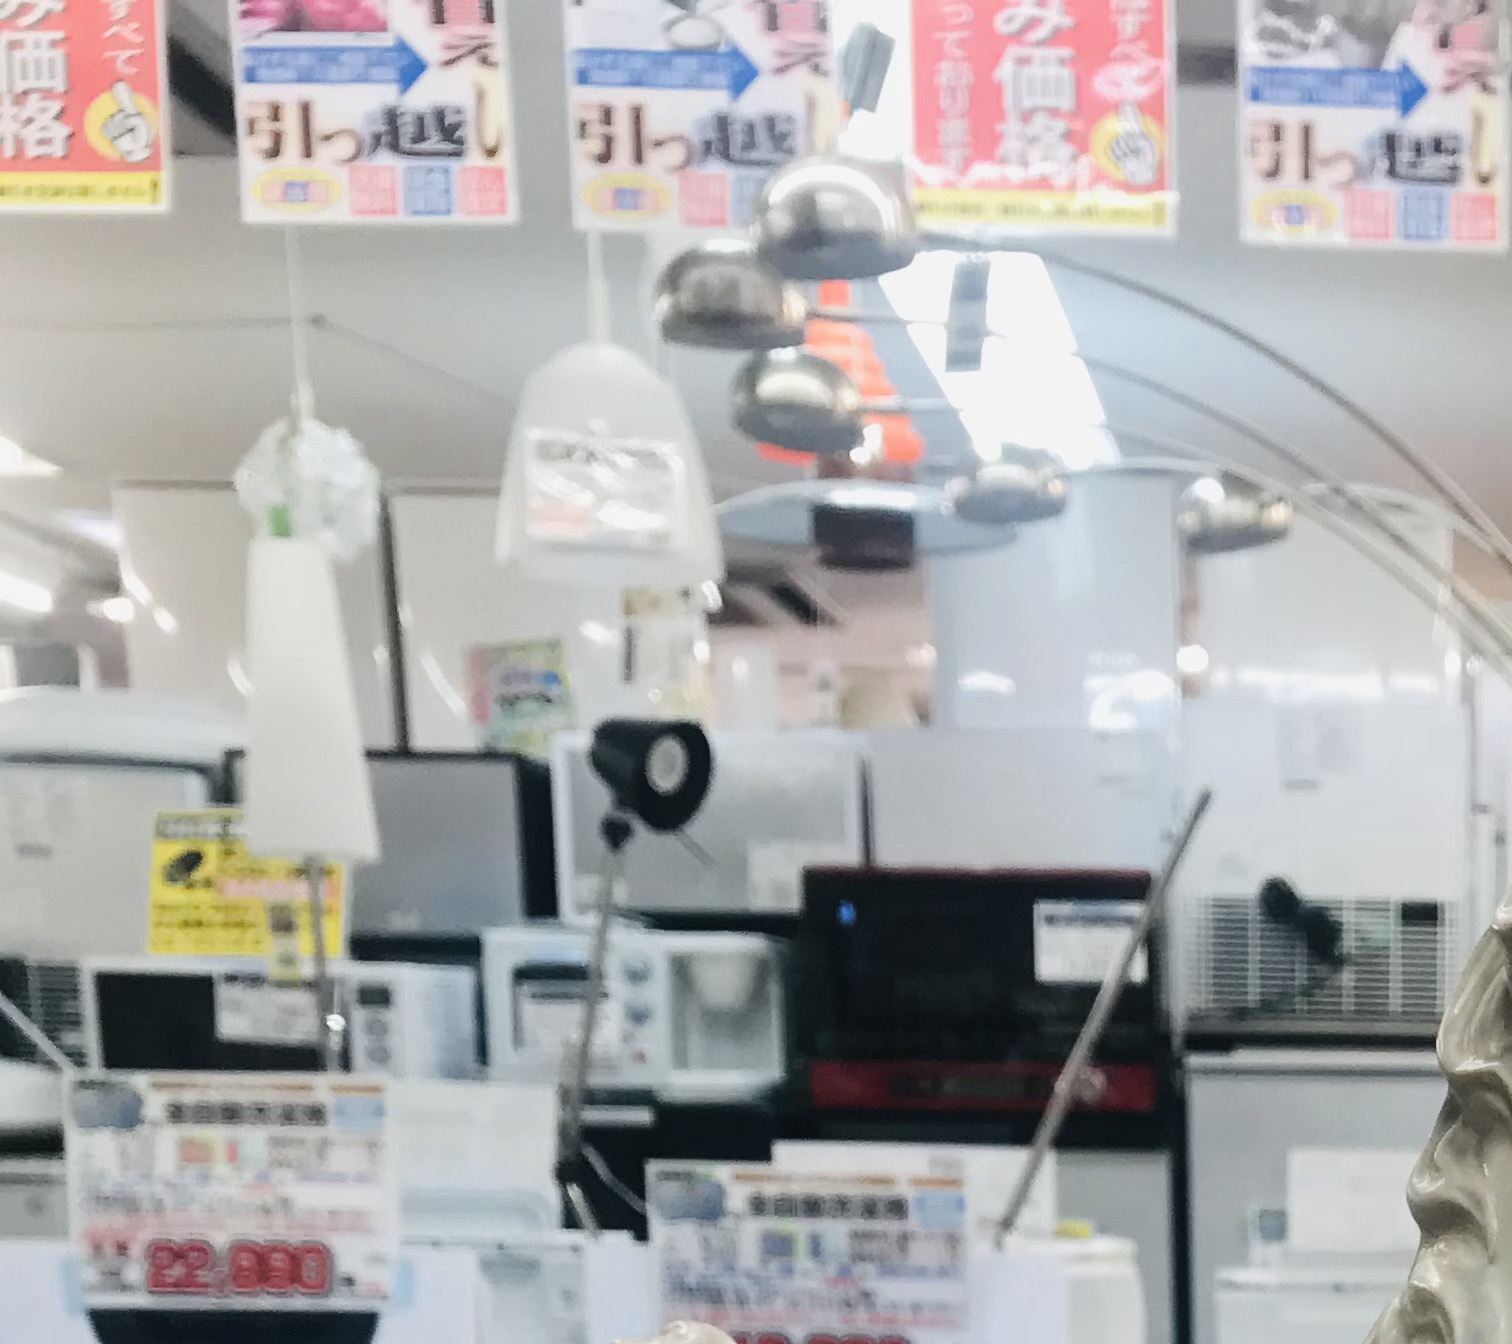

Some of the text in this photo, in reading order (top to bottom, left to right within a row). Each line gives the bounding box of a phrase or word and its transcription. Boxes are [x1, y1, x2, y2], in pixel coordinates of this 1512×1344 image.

[245, 84, 500, 163] 引っ越し
[1250, 108, 1498, 188] 引っ越し
